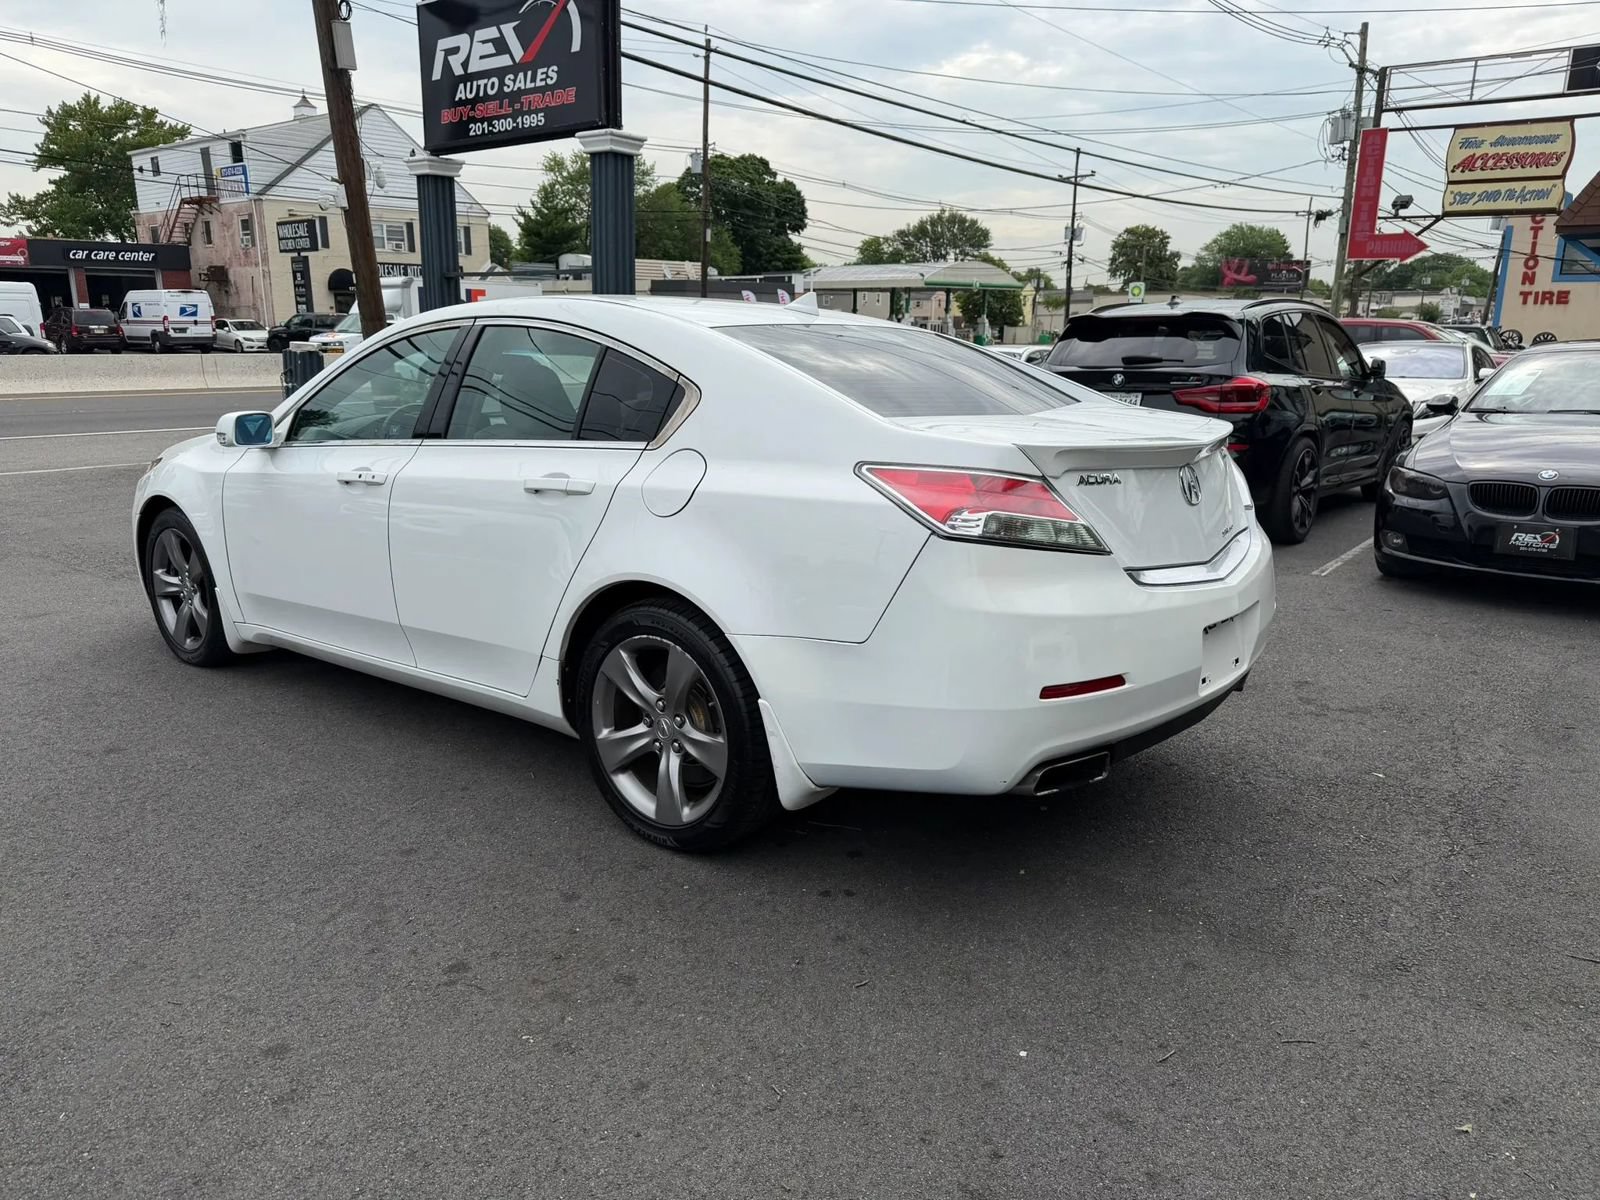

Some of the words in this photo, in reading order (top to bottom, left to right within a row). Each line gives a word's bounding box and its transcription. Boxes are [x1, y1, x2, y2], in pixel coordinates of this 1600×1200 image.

[455, 77, 499, 101] AUTO
[503, 65, 559, 91] SALES
[469, 112, 545, 136] 201-300-1995
[1450, 151, 1566, 173] ACCESSORIES
[277, 222, 309, 238] WHOLESALE
[69, 249, 89, 260] car
[91, 249, 116, 260] care
[118, 251, 155, 262] center
[1519, 290, 1571, 305] TIRE
[1076, 473, 1122, 487] ACURA
[1509, 540, 1557, 549] MOTORS
